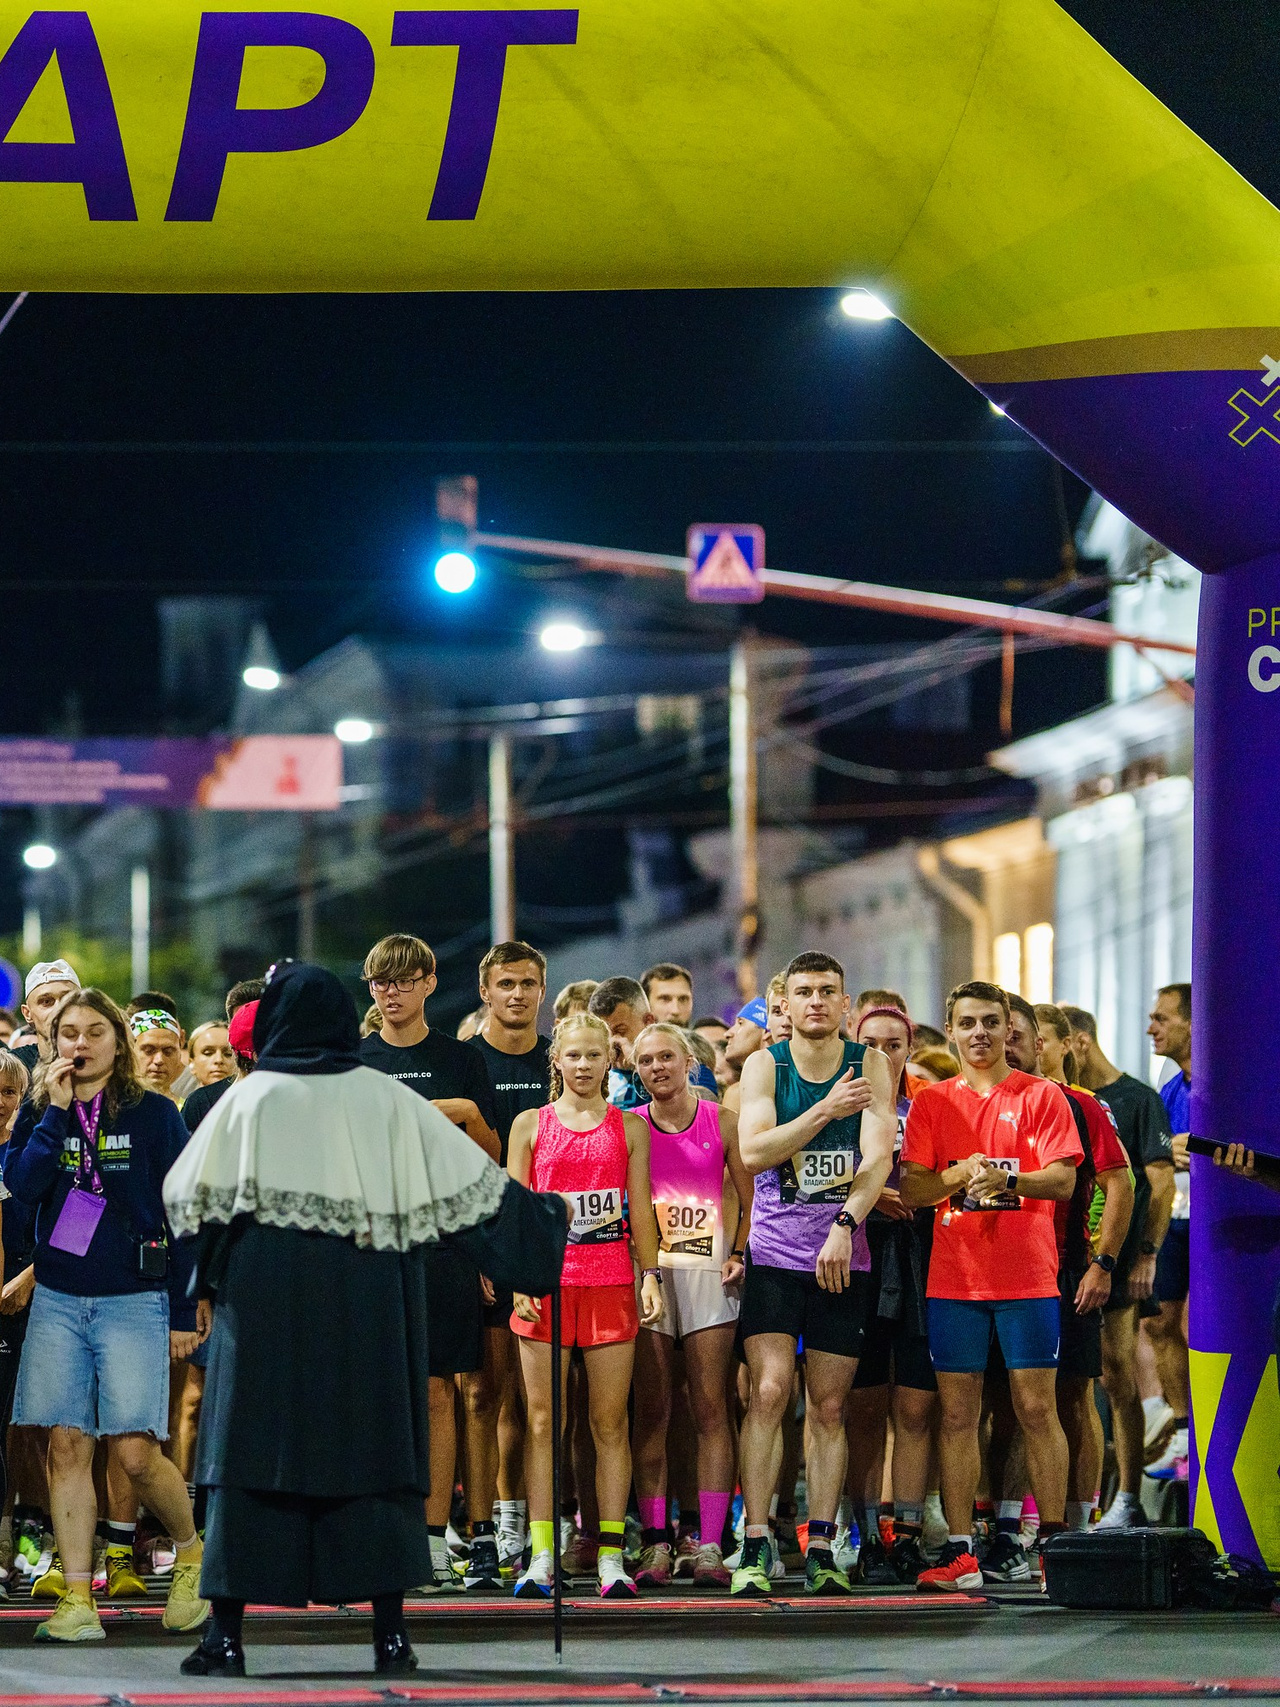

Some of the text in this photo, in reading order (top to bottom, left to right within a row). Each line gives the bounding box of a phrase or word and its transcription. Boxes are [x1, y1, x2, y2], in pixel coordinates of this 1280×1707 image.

[495, 1083, 542, 1091] appzone.co
[804, 1154, 846, 1178] 350
[804, 1178, 836, 1187] ВЛАДИСЛАВ
[576, 1191, 615, 1217] 194
[573, 1217, 607, 1227] АЛЕКСАНДРА
[667, 1206, 707, 1230] 302
[667, 1229, 695, 1237] АНАСТАСИЯ
